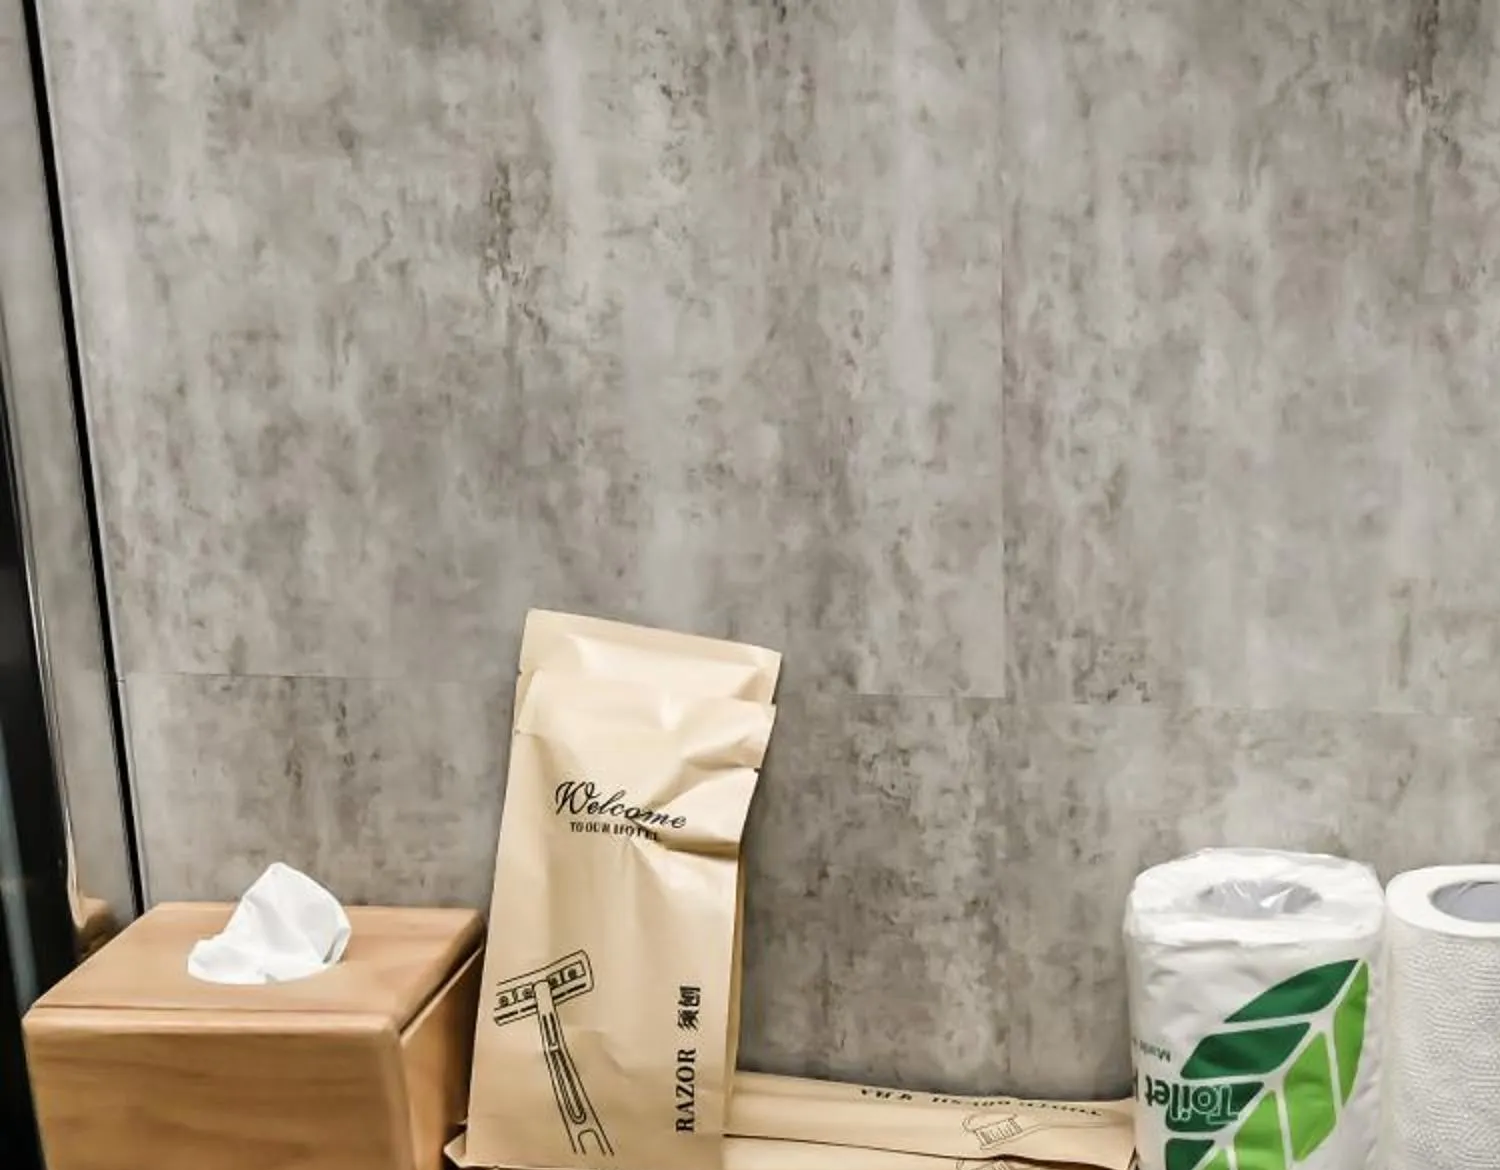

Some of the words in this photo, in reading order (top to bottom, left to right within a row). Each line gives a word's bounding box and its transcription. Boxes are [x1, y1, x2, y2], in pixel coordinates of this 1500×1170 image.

[555, 781, 687, 829] Welcome
[675, 1048, 696, 1133] RAZOR
[1144, 1074, 1240, 1125] Toilet
